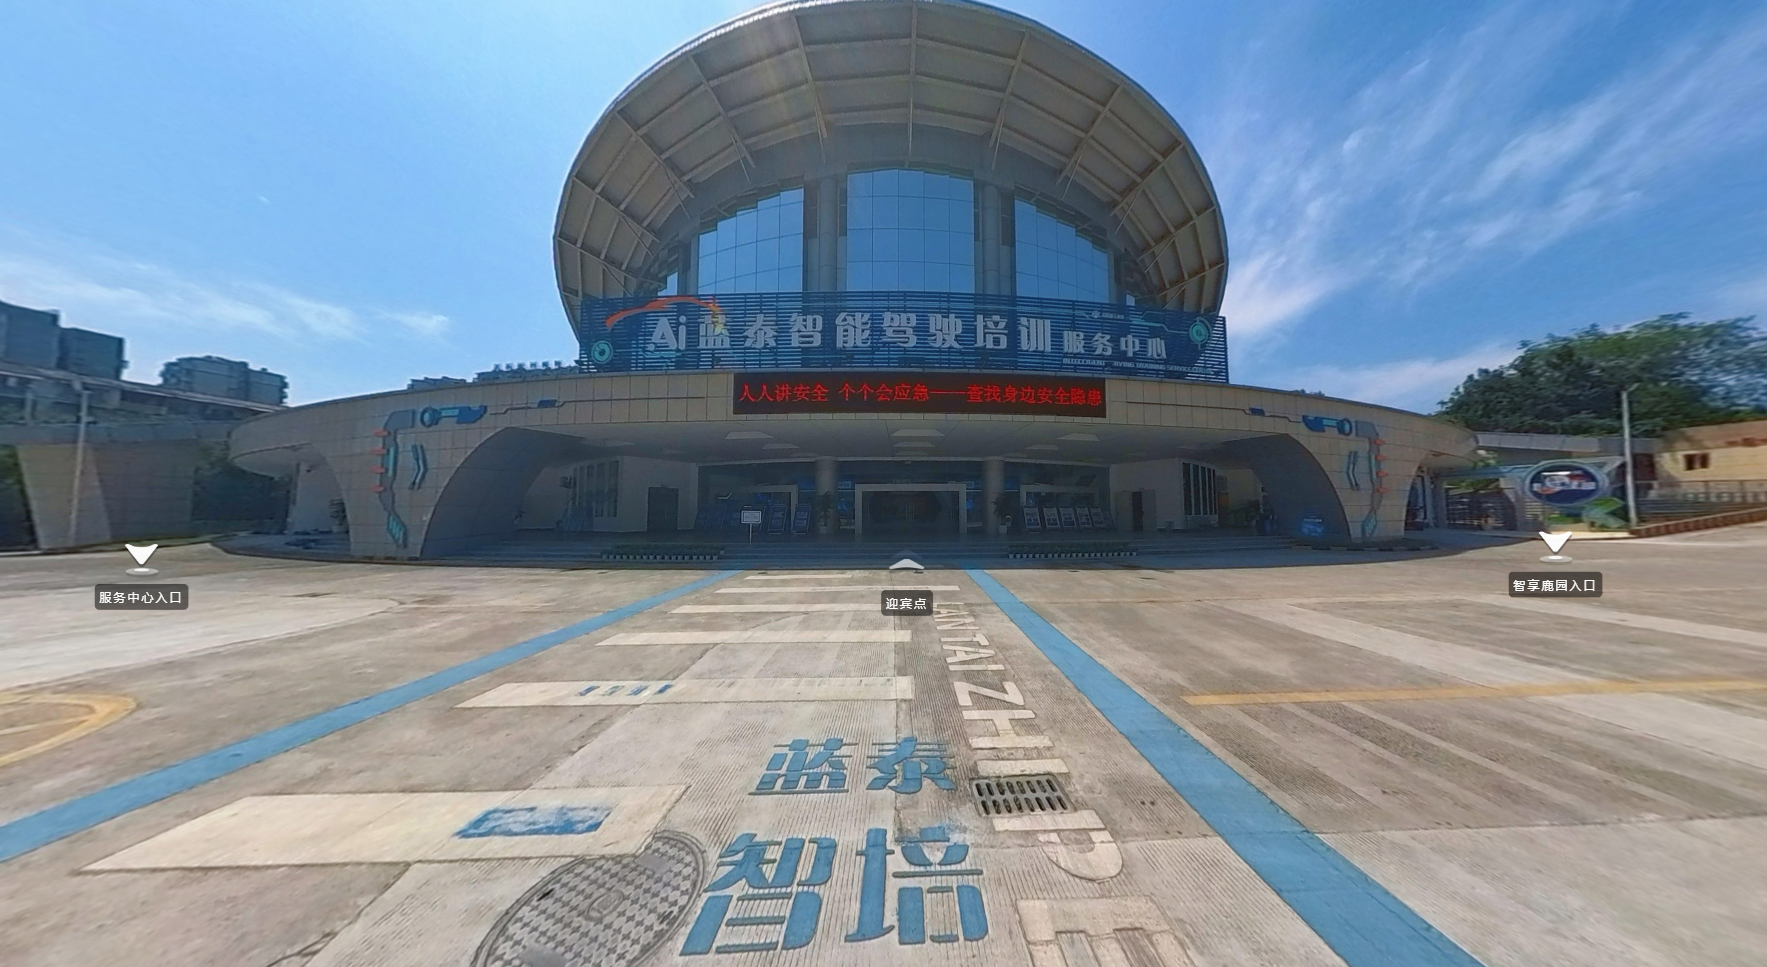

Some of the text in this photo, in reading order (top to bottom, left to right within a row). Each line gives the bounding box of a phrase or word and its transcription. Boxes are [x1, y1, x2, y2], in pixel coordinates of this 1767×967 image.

[697, 312, 1051, 352] 蓝泰智能驾驶培训
[1063, 330, 1167, 359] 服务中心
[737, 382, 829, 402] 人人讲安全
[748, 737, 957, 795] 蓝泰
[679, 826, 989, 958] 智培
